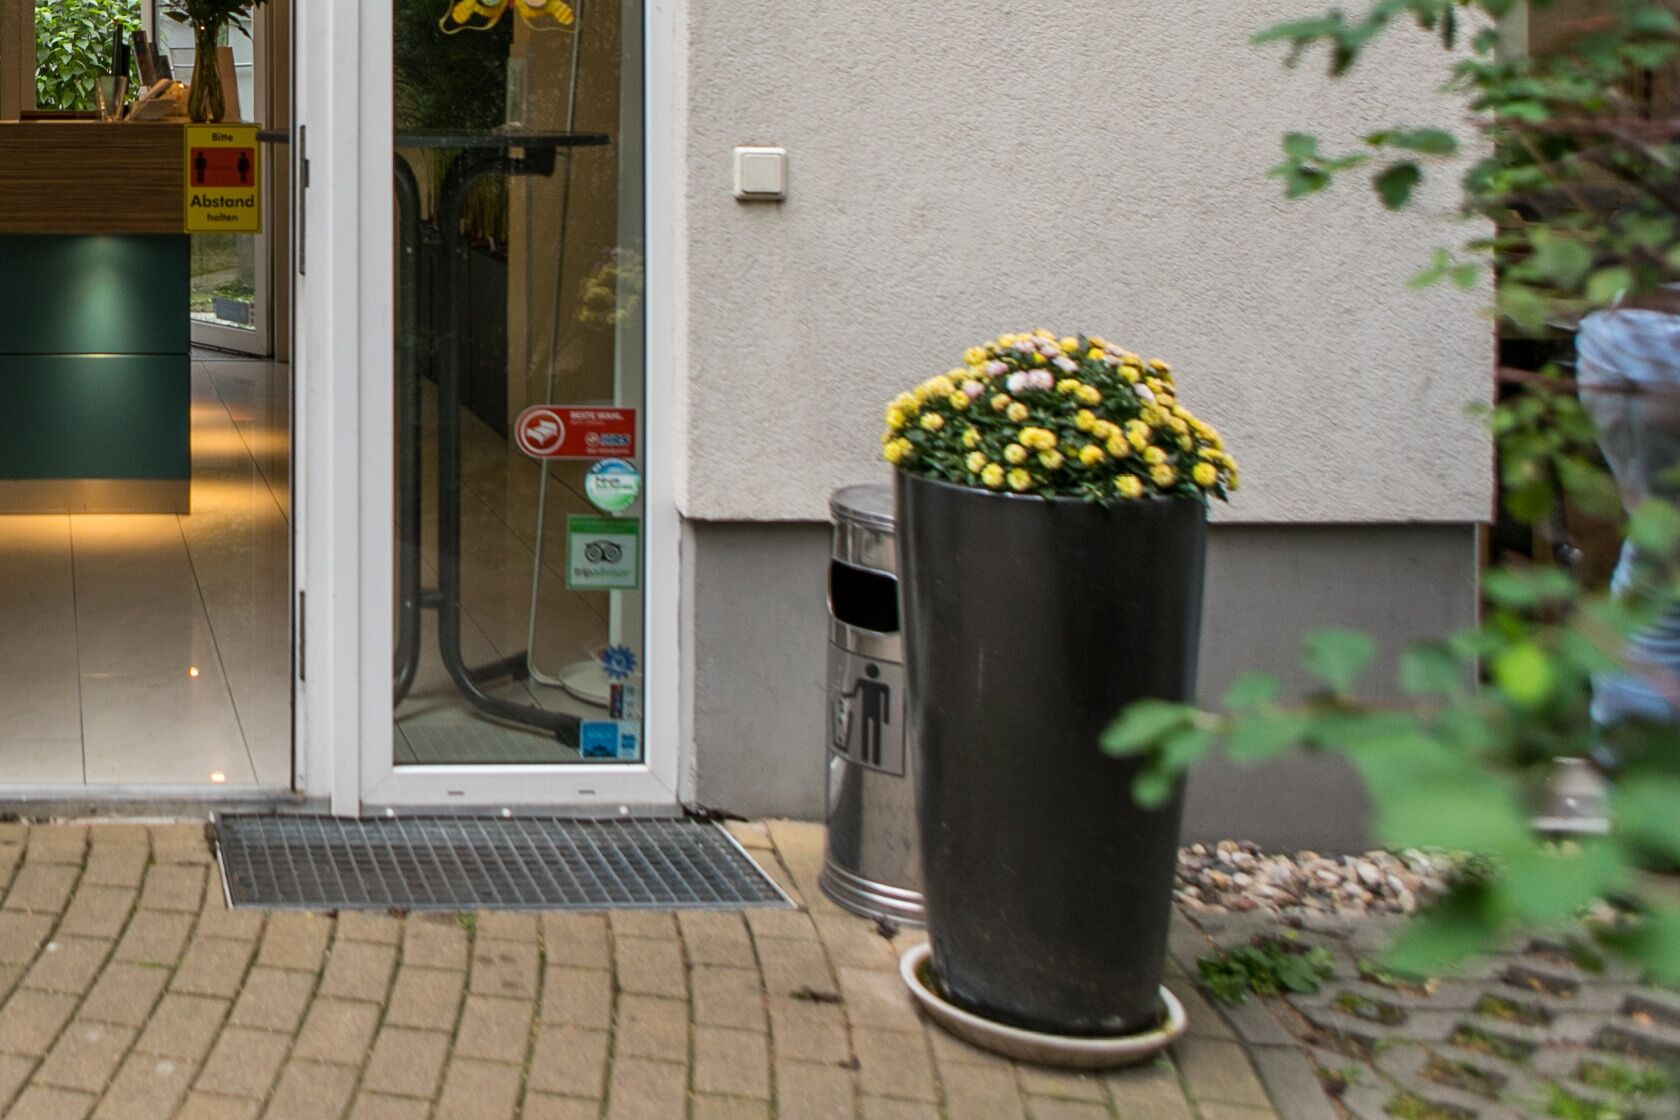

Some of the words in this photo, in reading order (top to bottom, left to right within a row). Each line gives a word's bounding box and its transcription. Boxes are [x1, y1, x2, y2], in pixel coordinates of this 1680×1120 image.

[211, 132, 235, 142] Bitte
[190, 193, 255, 208] Abstand
[206, 212, 239, 222] halten
